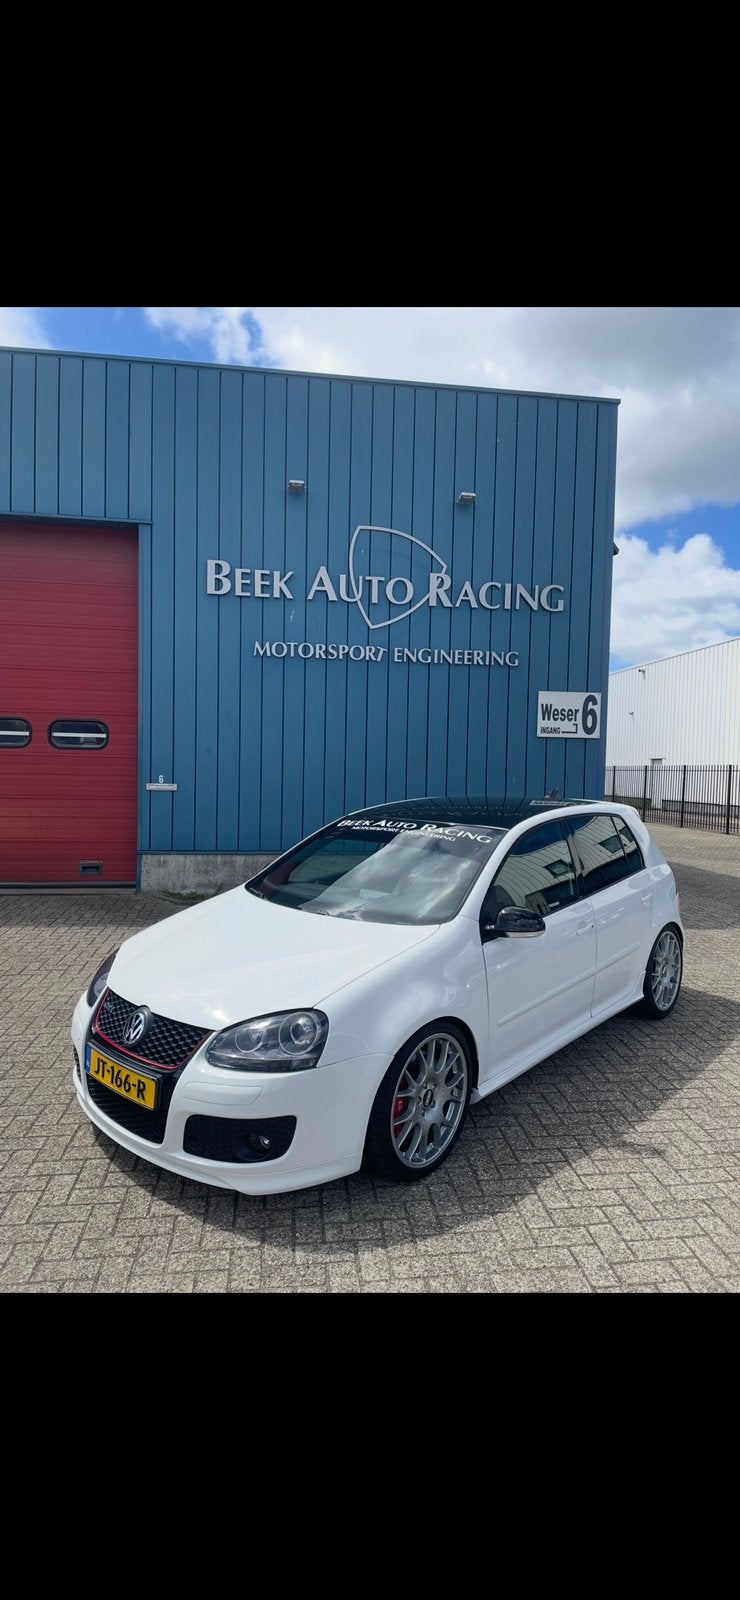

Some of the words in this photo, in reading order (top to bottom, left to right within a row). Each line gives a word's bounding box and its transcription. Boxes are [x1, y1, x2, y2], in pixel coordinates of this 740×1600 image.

[206, 559, 294, 600] BEEK
[307, 565, 414, 605] AUTO
[428, 572, 565, 612] RACING
[253, 641, 387, 662] MOTORSPORT
[393, 647, 519, 667] ENGINEERING
[541, 703, 579, 721] Weser
[582, 694, 598, 735] 6
[540, 726, 560, 734] INGANG
[158, 774, 164, 784] 6
[336, 819, 374, 828] BEEK
[376, 819, 417, 830] AUTO
[419, 823, 493, 844] RACING
[400, 829, 457, 842] ENGINEERING
[94, 1057, 146, 1101] JT-166-R
